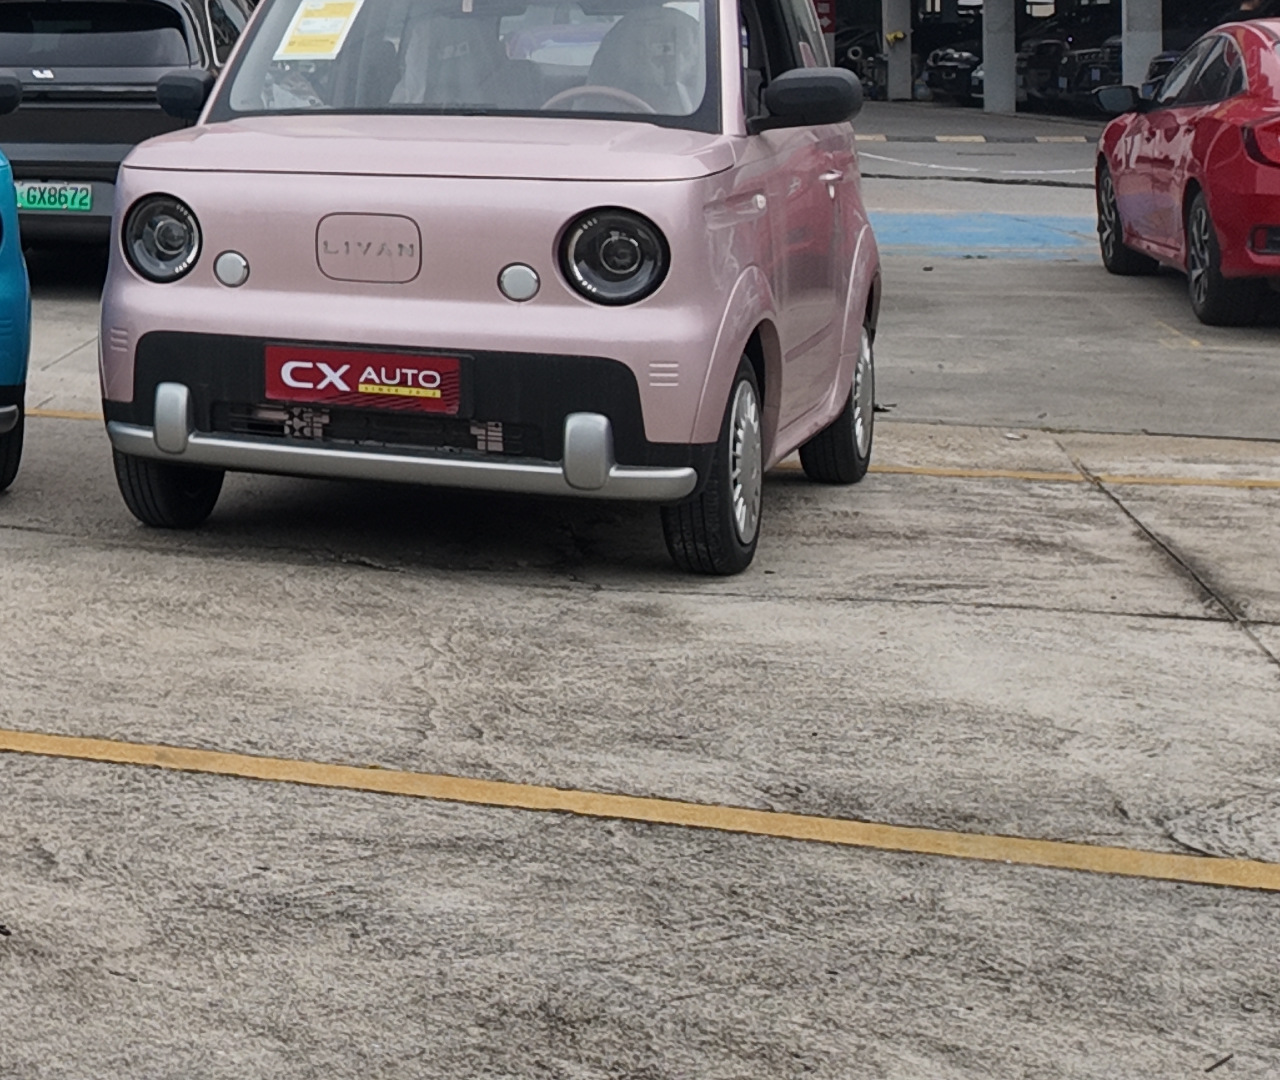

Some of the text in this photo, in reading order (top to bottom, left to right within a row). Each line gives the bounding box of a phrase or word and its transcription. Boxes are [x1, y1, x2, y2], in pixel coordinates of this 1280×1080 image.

[323, 239, 416, 259] LIVAN
[280, 361, 441, 392] CX AUTO
